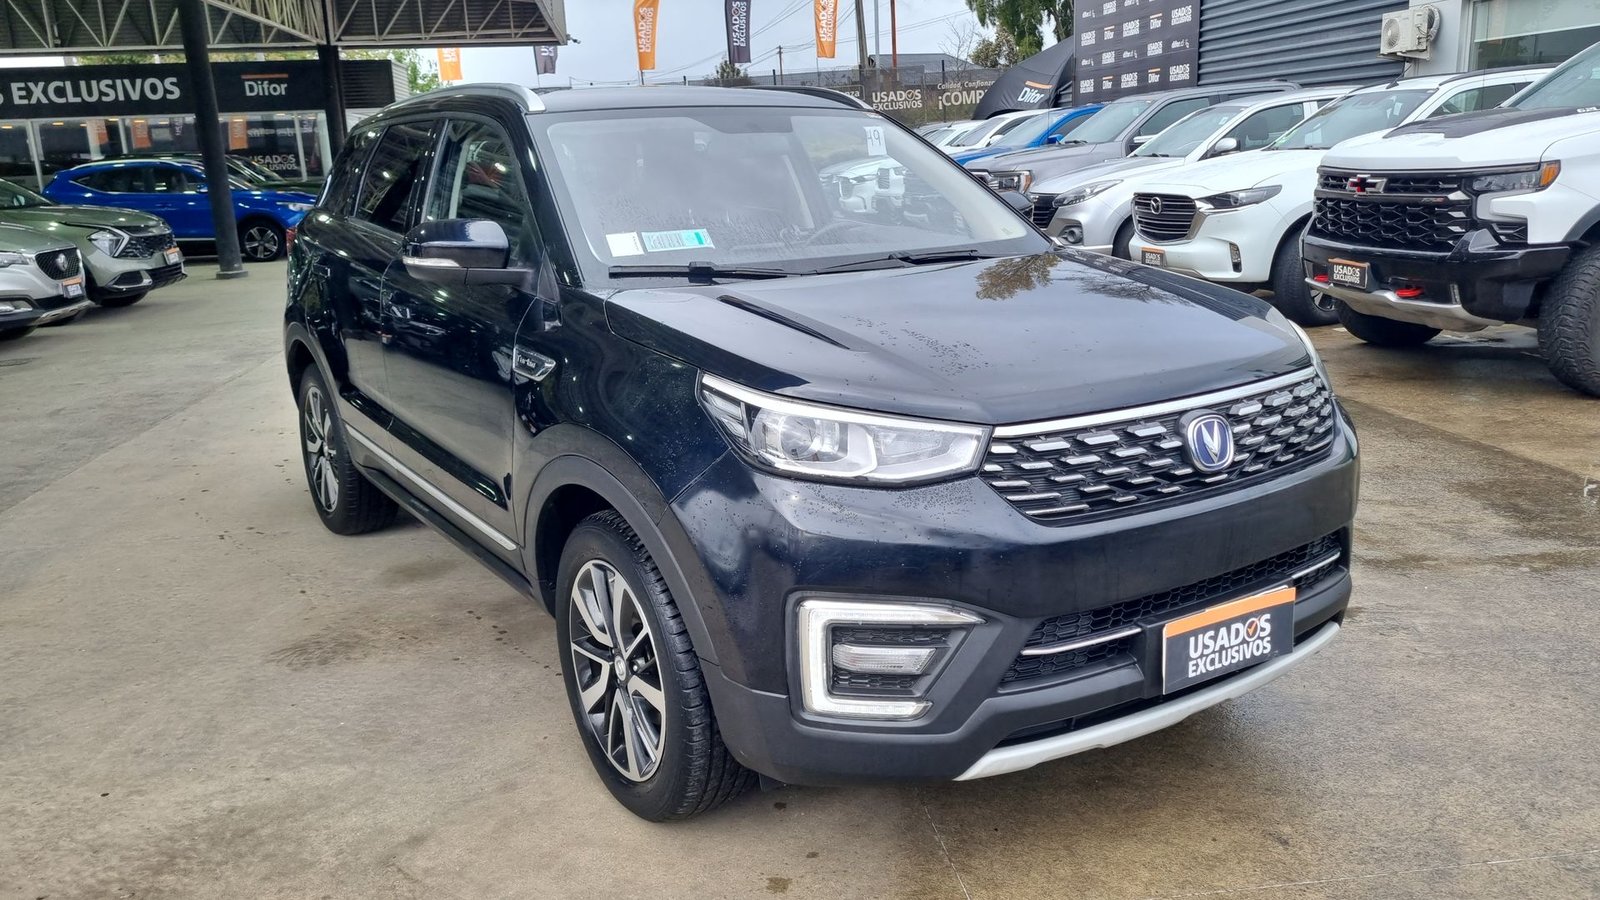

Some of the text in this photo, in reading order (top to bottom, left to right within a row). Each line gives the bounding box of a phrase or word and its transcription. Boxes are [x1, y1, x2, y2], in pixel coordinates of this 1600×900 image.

[732, 1, 740, 46] USADOS
[739, 1, 747, 47] EXCLUSIVOS
[11, 77, 181, 105] EXCLUSIVOS
[244, 81, 288, 96] Difor
[872, 89, 922, 103] USADOS
[1017, 87, 1045, 104] Difor
[872, 100, 923, 110] EXCLUSIVOS
[1333, 264, 1360, 277] USADOS
[1189, 613, 1271, 659] USADOS
[1188, 636, 1271, 678] EXCLUSIVOS
